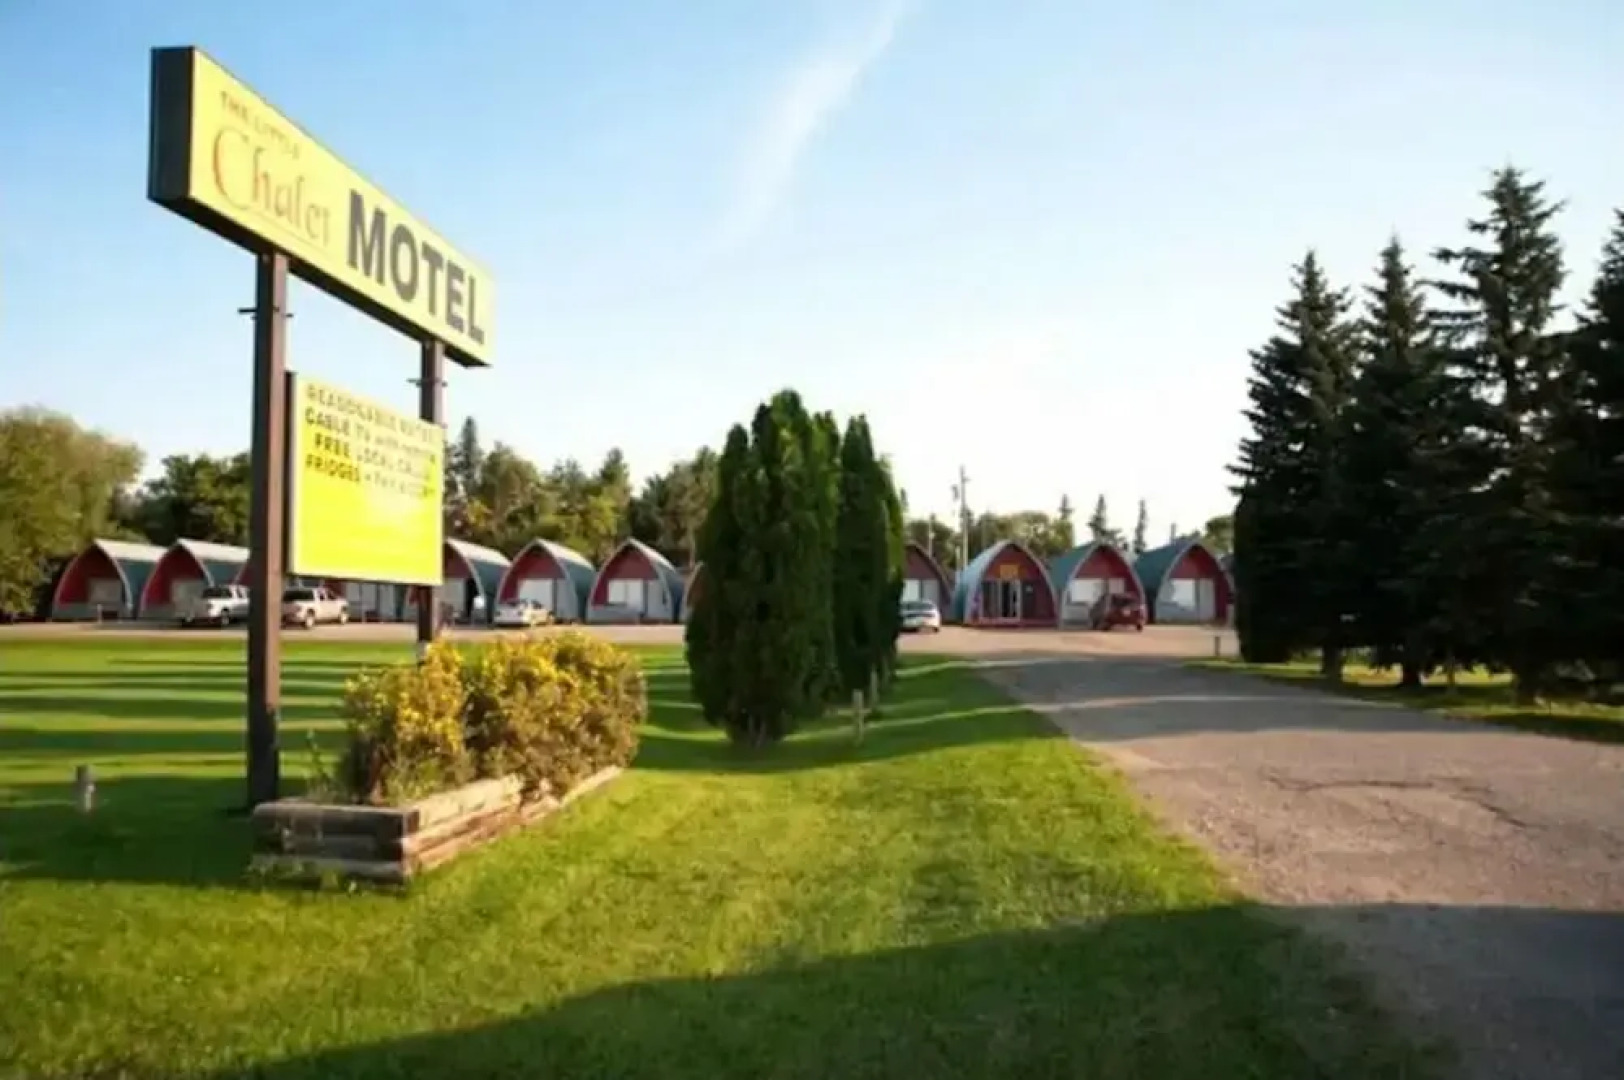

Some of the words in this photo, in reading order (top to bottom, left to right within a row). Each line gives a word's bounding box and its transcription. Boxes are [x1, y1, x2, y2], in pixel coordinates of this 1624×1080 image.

[212, 125, 331, 248] Chalet
[347, 188, 485, 345] MOTEL
[305, 406, 350, 436] CABLE
[315, 432, 350, 458] FREE
[305, 453, 360, 483] FRIDGES
